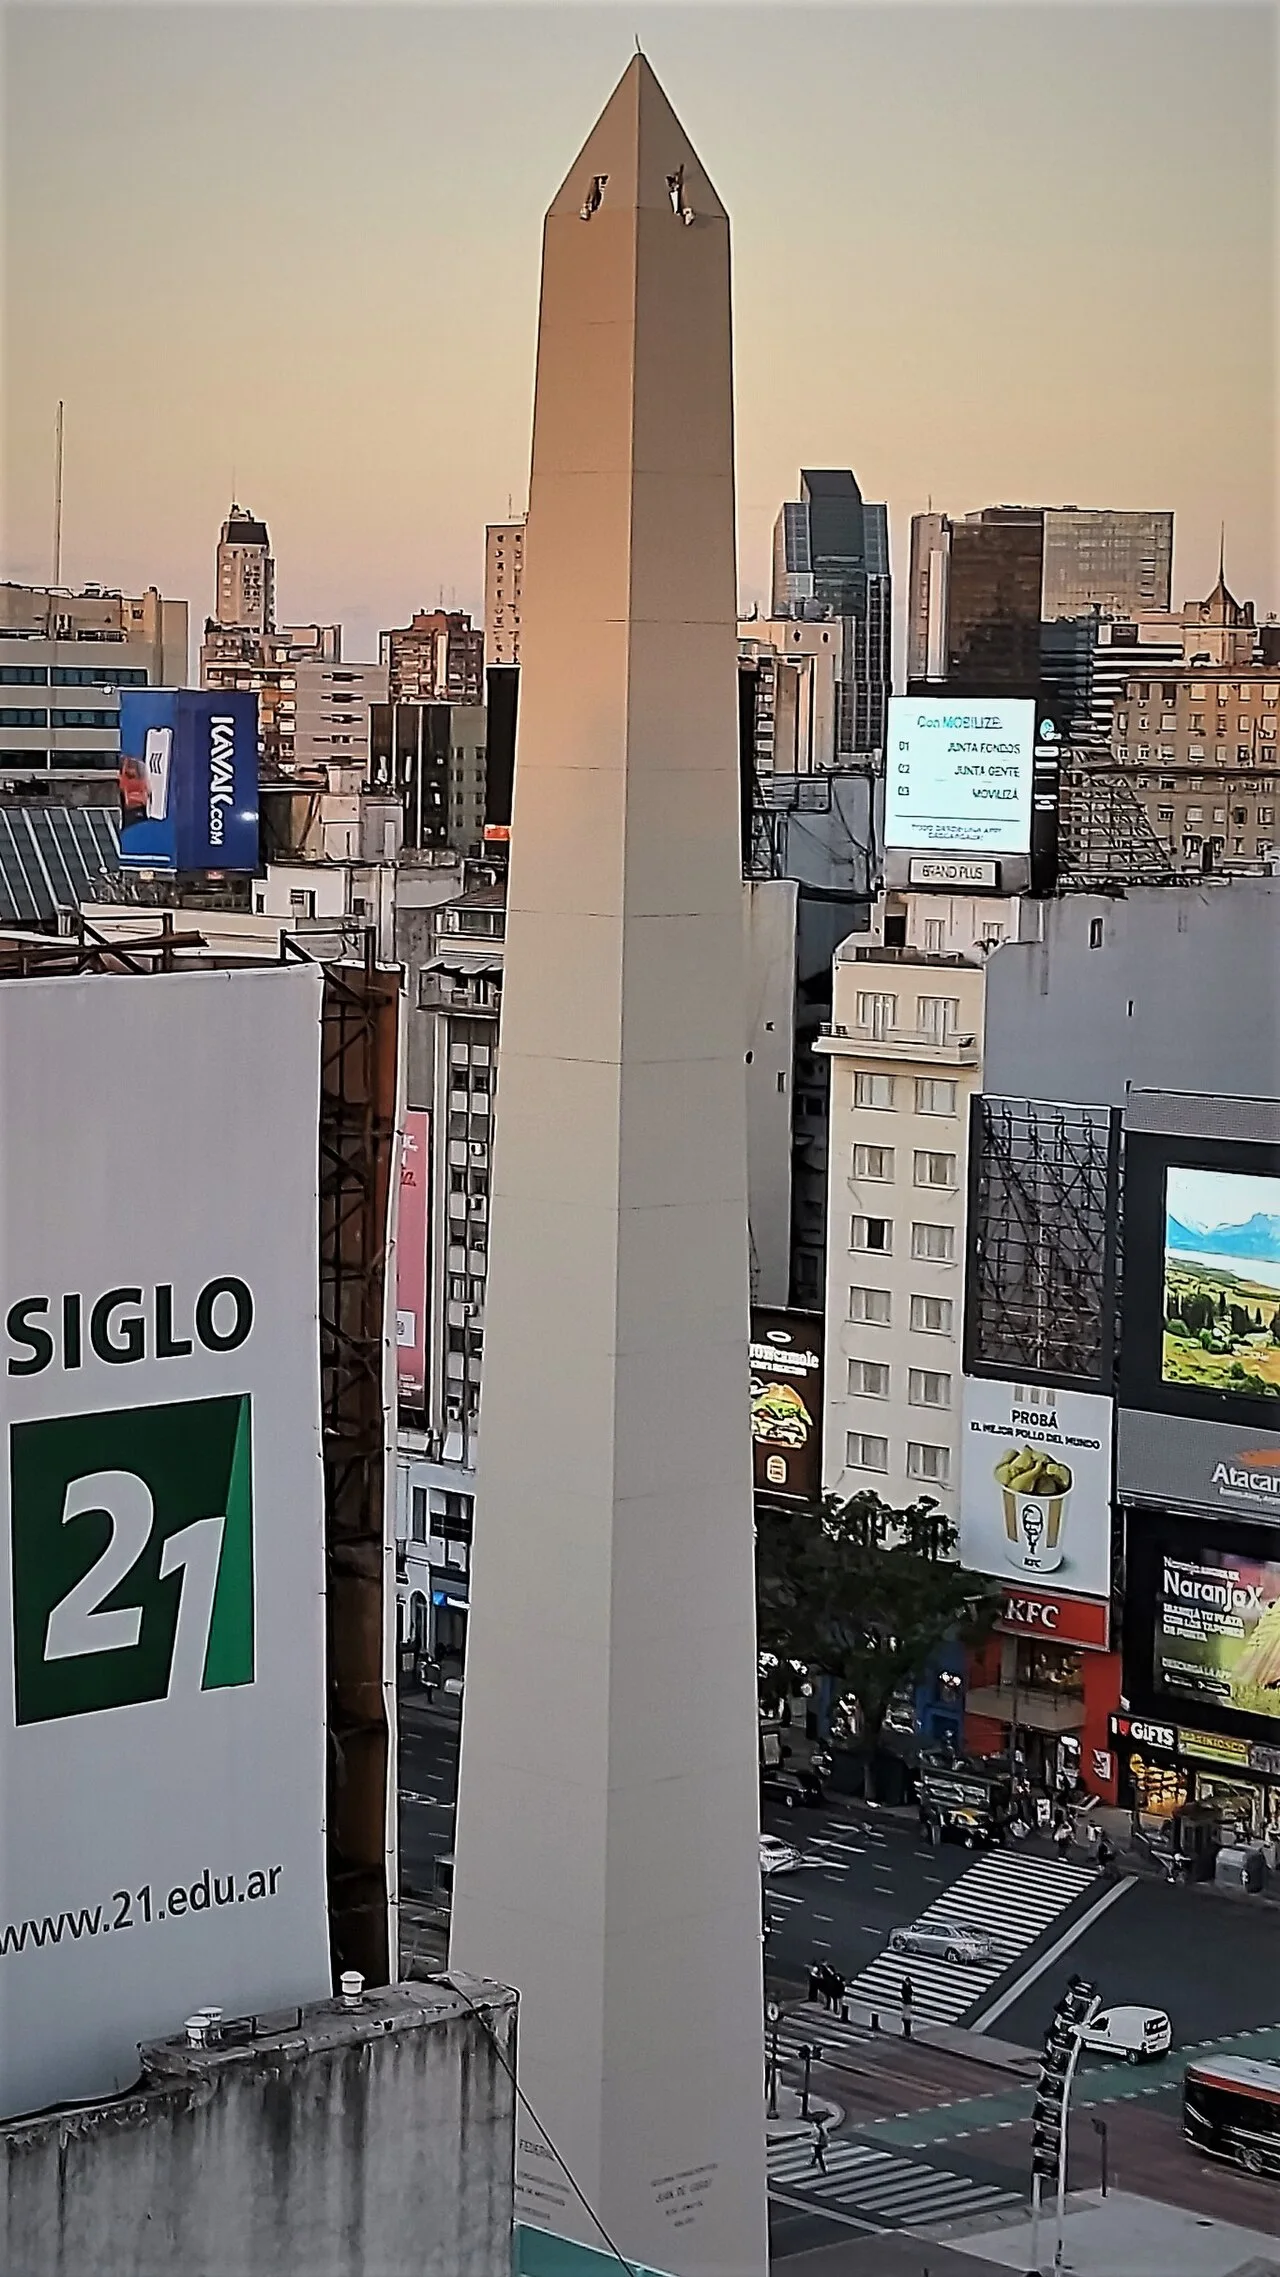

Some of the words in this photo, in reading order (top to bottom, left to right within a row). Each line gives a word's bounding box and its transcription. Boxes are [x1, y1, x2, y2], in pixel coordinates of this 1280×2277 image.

[917, 715, 941, 729] Con
[943, 716, 1003, 730] MOBILIZE
[947, 742, 978, 753] JUNTA
[954, 765, 985, 776] JUNTA
[988, 766, 1020, 778] GENTE
[959, 866, 983, 880] PLUS
[6, 1276, 254, 1377] SIGLO
[1011, 1409, 1059, 1429] PROBÁ
[970, 1421, 982, 1432] EL
[983, 1424, 1014, 1437] MEJOR
[1015, 1428, 1045, 1441] POLLO
[1046, 1433, 1064, 1445] DEL
[1065, 1436, 1101, 1450] MUNDO
[1023, 1557, 1042, 1568] KFC
[44, 1469, 227, 1699] 21
[1004, 1598, 1060, 1629] KFC
[0, 1866, 283, 1955] www.21.edu.ar
